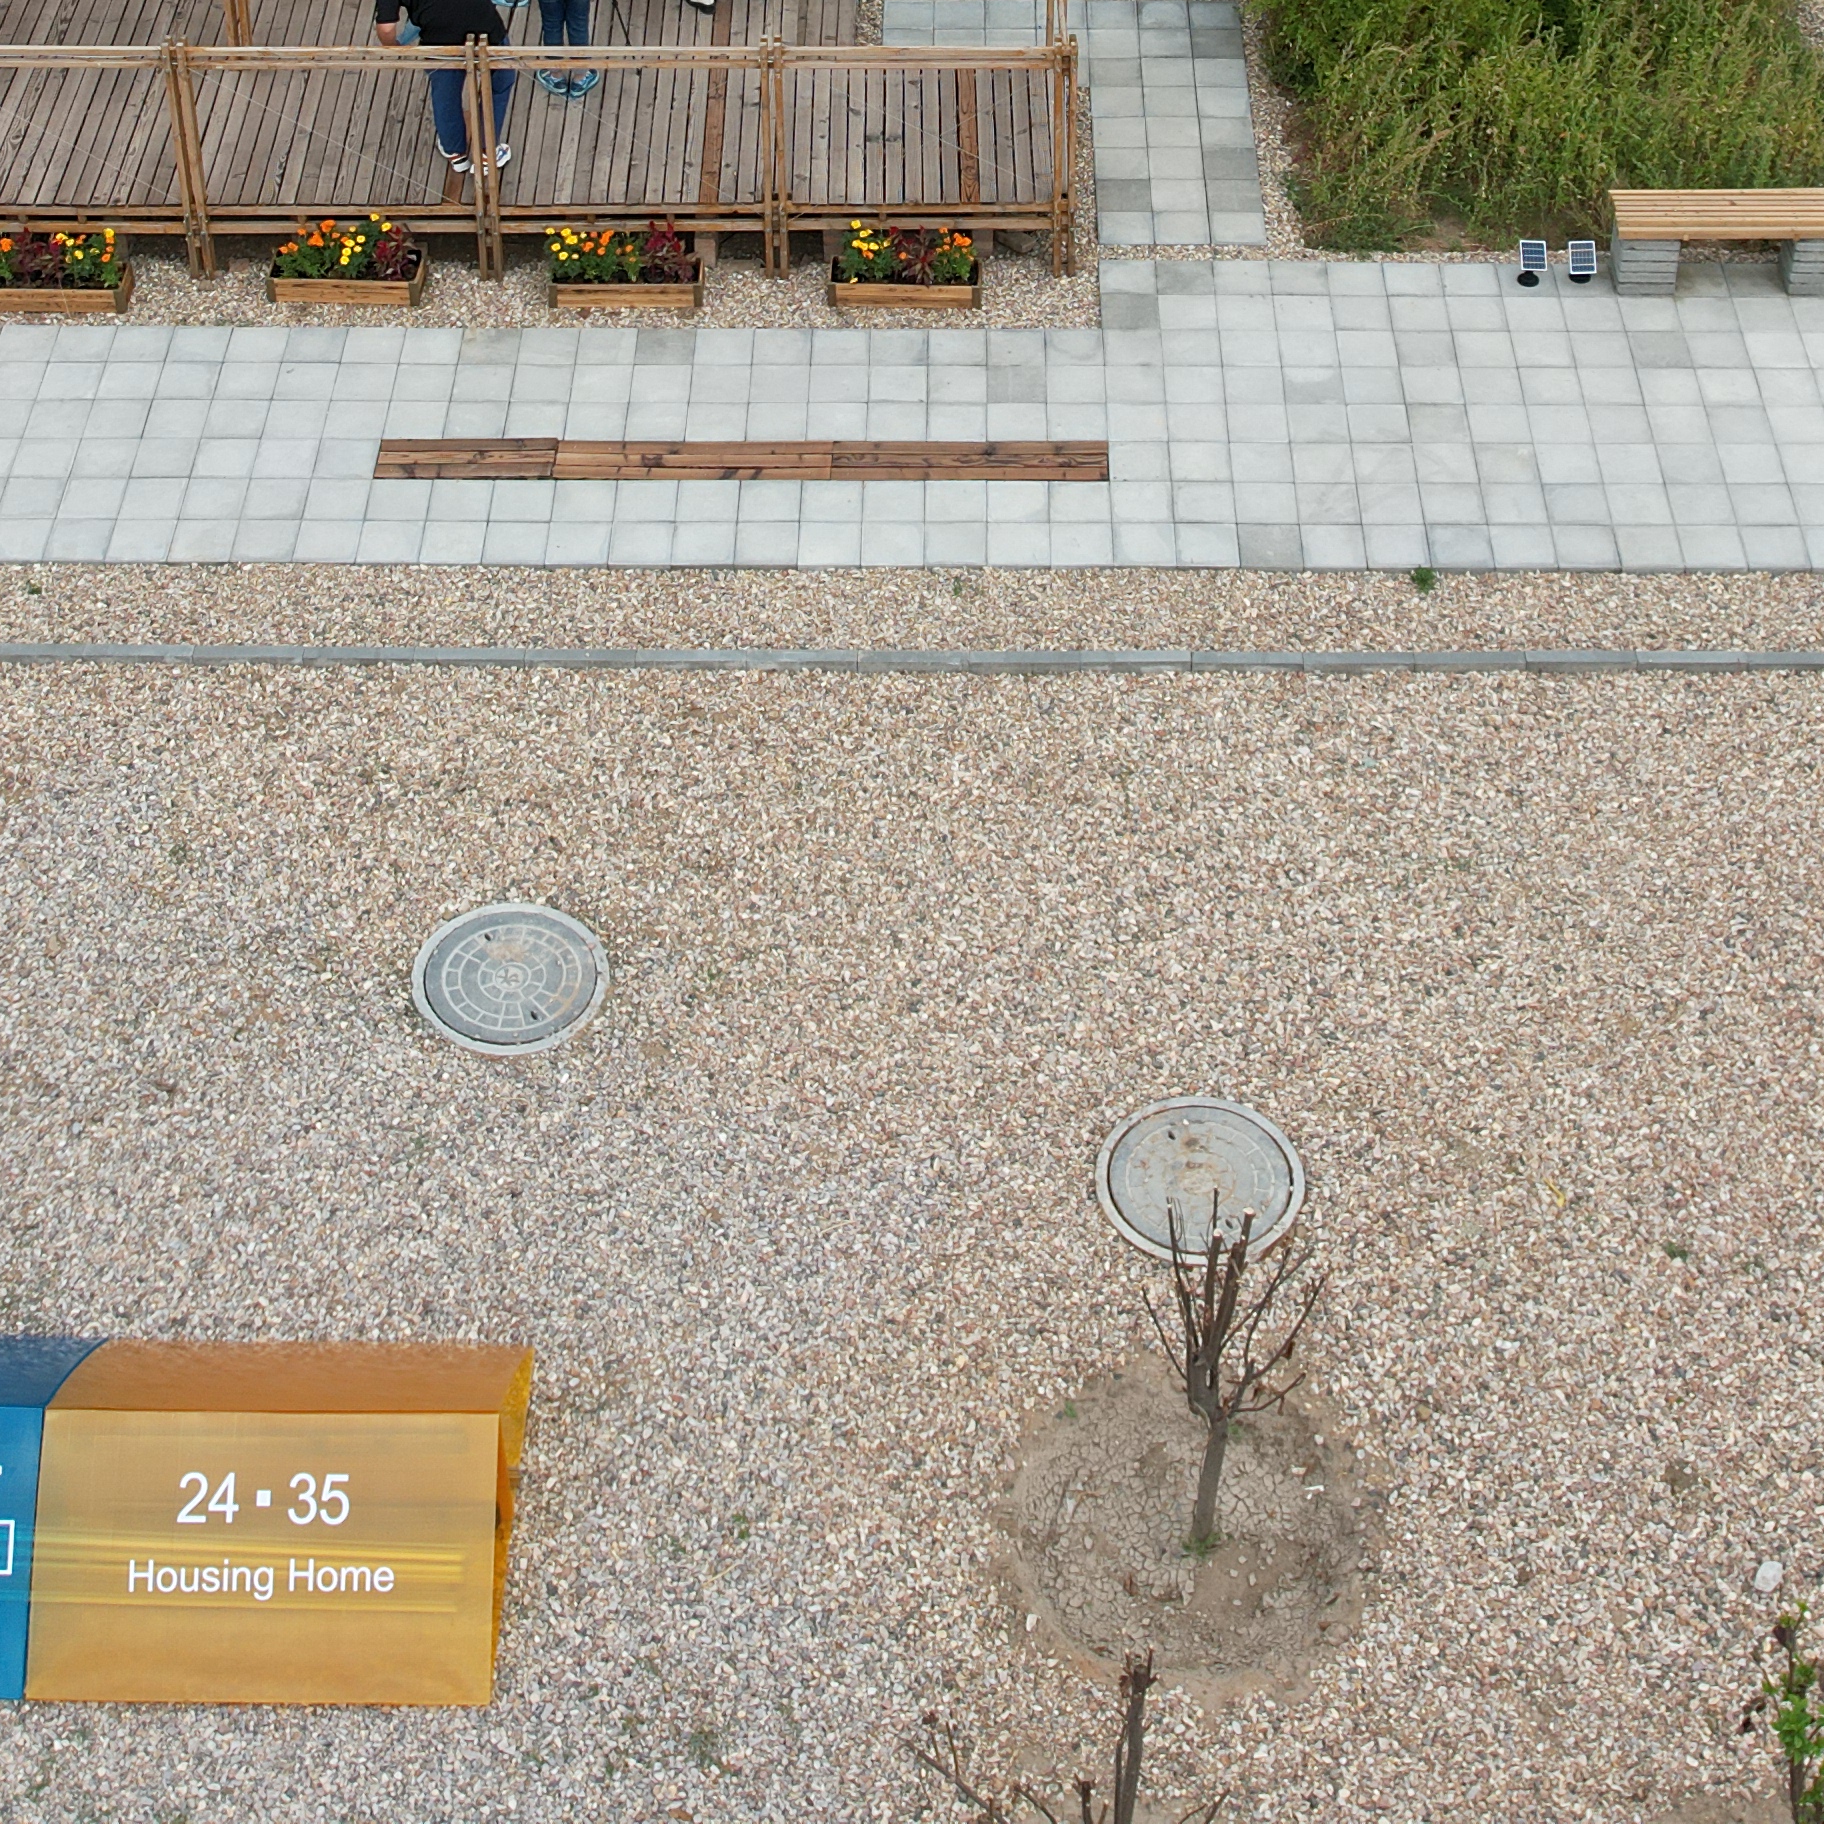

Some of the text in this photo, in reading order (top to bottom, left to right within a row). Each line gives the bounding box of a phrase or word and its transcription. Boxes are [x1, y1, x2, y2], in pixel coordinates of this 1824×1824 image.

[176, 1471, 239, 1523] 24
[287, 1472, 350, 1525] 35
[128, 1558, 395, 1601] Housing Home
